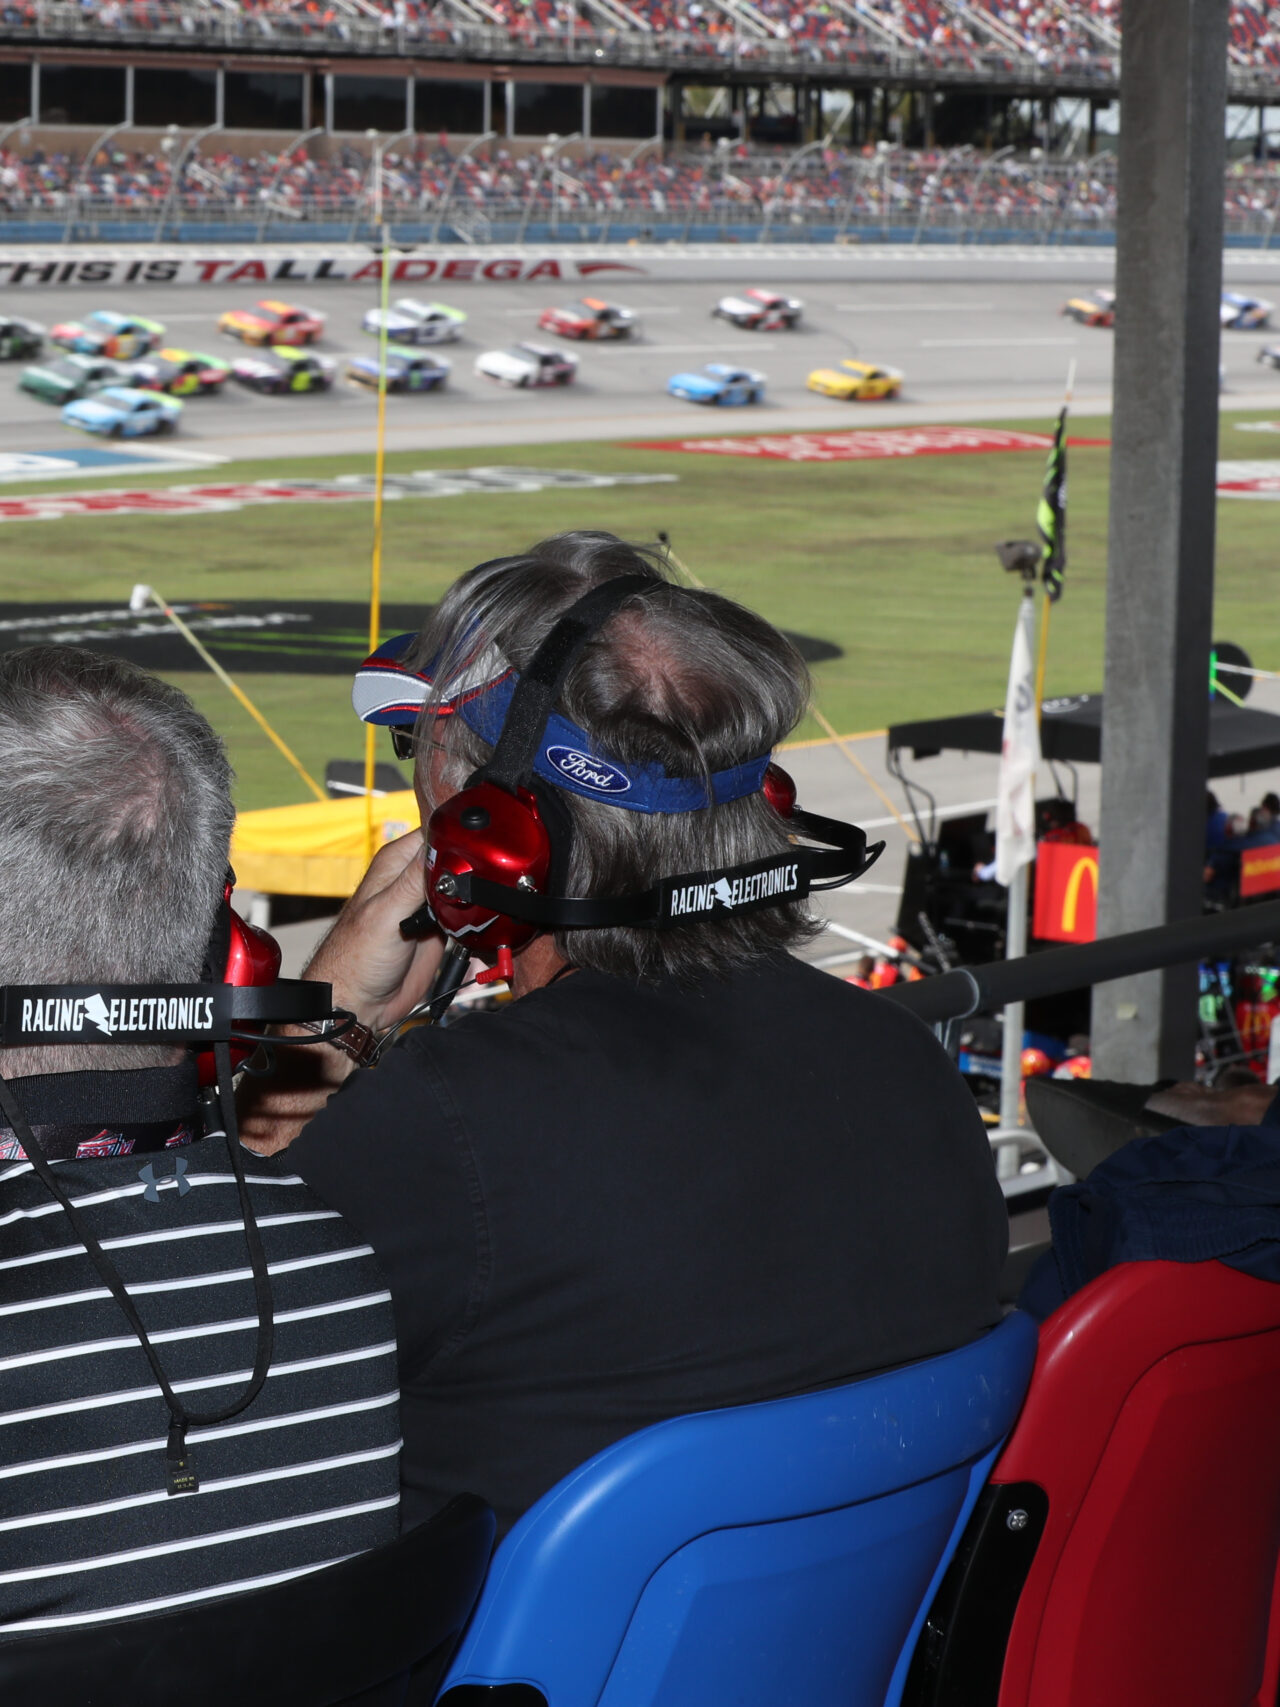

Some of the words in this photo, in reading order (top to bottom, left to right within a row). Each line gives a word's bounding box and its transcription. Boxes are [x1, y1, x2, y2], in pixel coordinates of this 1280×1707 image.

[123, 260, 183, 283] IS
[194, 259, 563, 283] TALLADEGA
[559, 752, 615, 788] Ford
[670, 882, 716, 917] RACING
[730, 863, 799, 906] ELECTRONICS
[21, 998, 85, 1032] RACING
[108, 996, 214, 1032] ELECTRONICS
